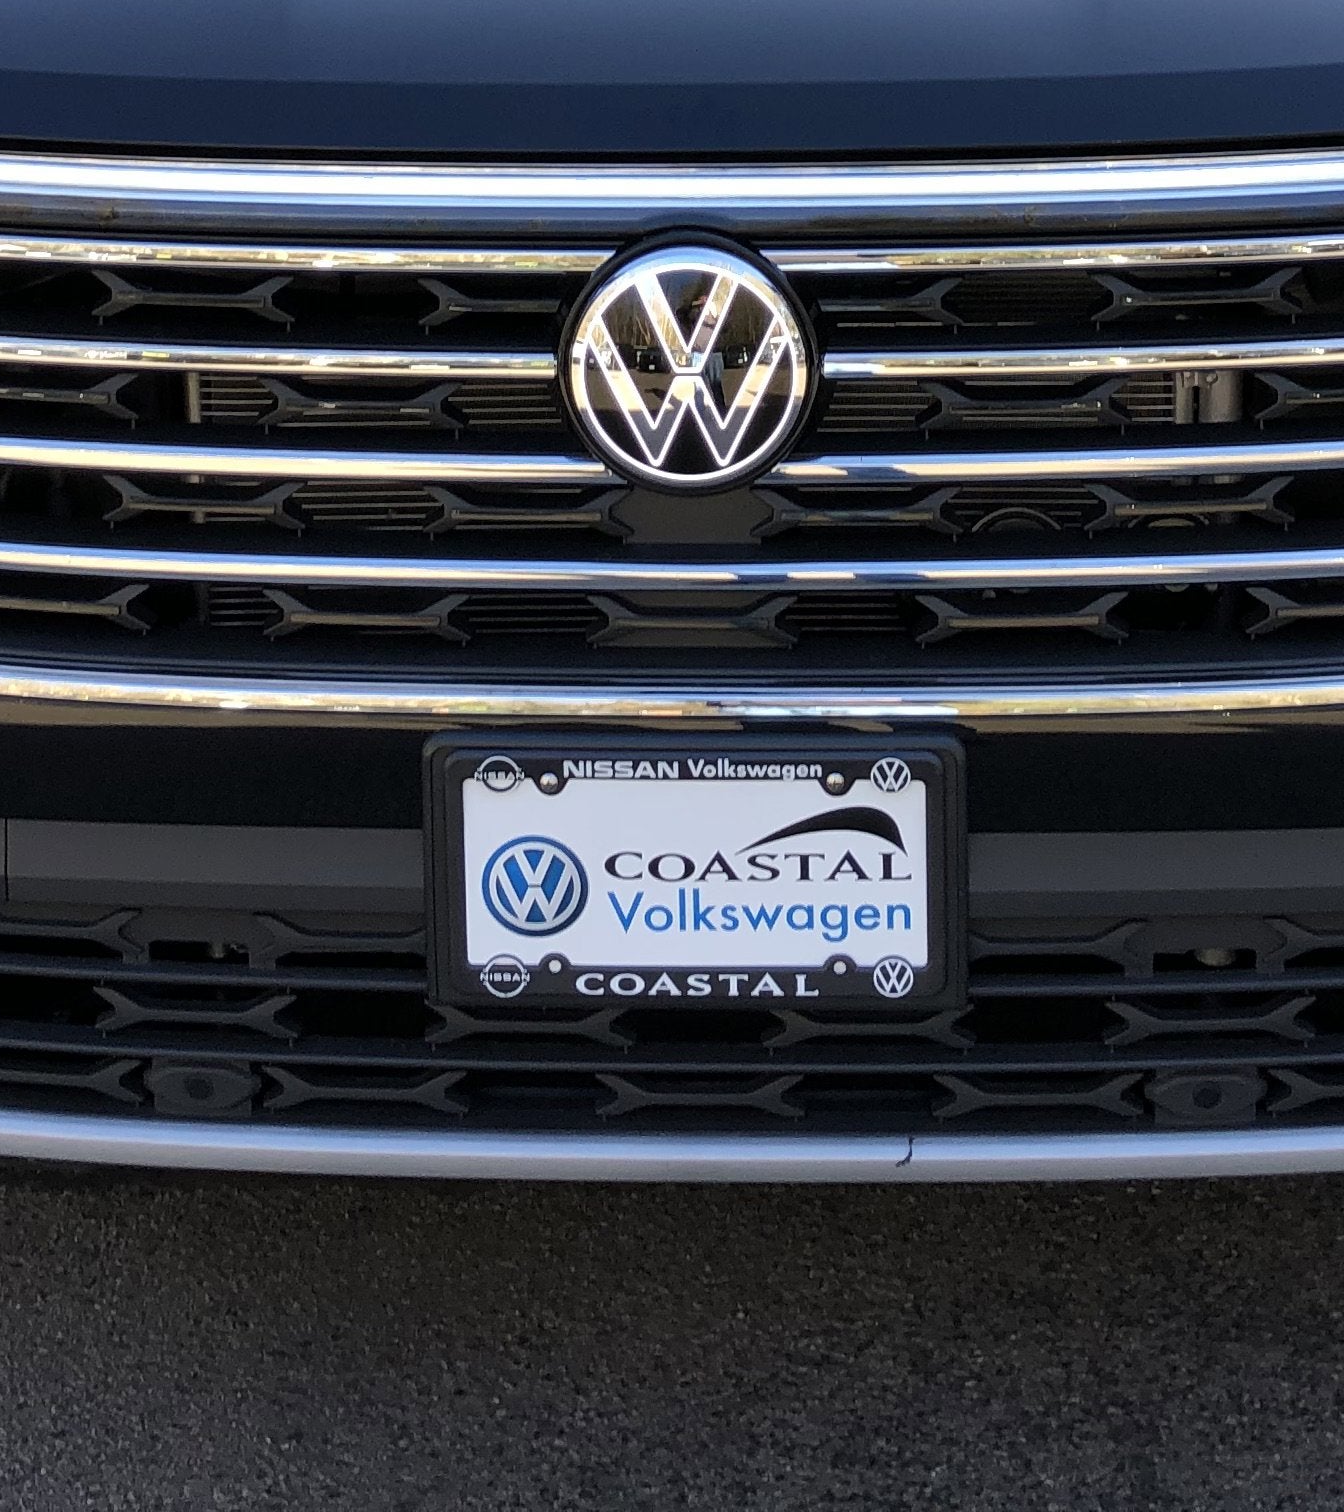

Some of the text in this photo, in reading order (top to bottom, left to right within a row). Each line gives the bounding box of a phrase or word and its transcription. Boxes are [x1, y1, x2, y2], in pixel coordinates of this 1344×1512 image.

[563, 758, 823, 782] NISSAN Volkswagen
[603, 849, 912, 883] COASTAL
[607, 888, 912, 942] Volkswagen
[575, 972, 820, 997] COASTAL
